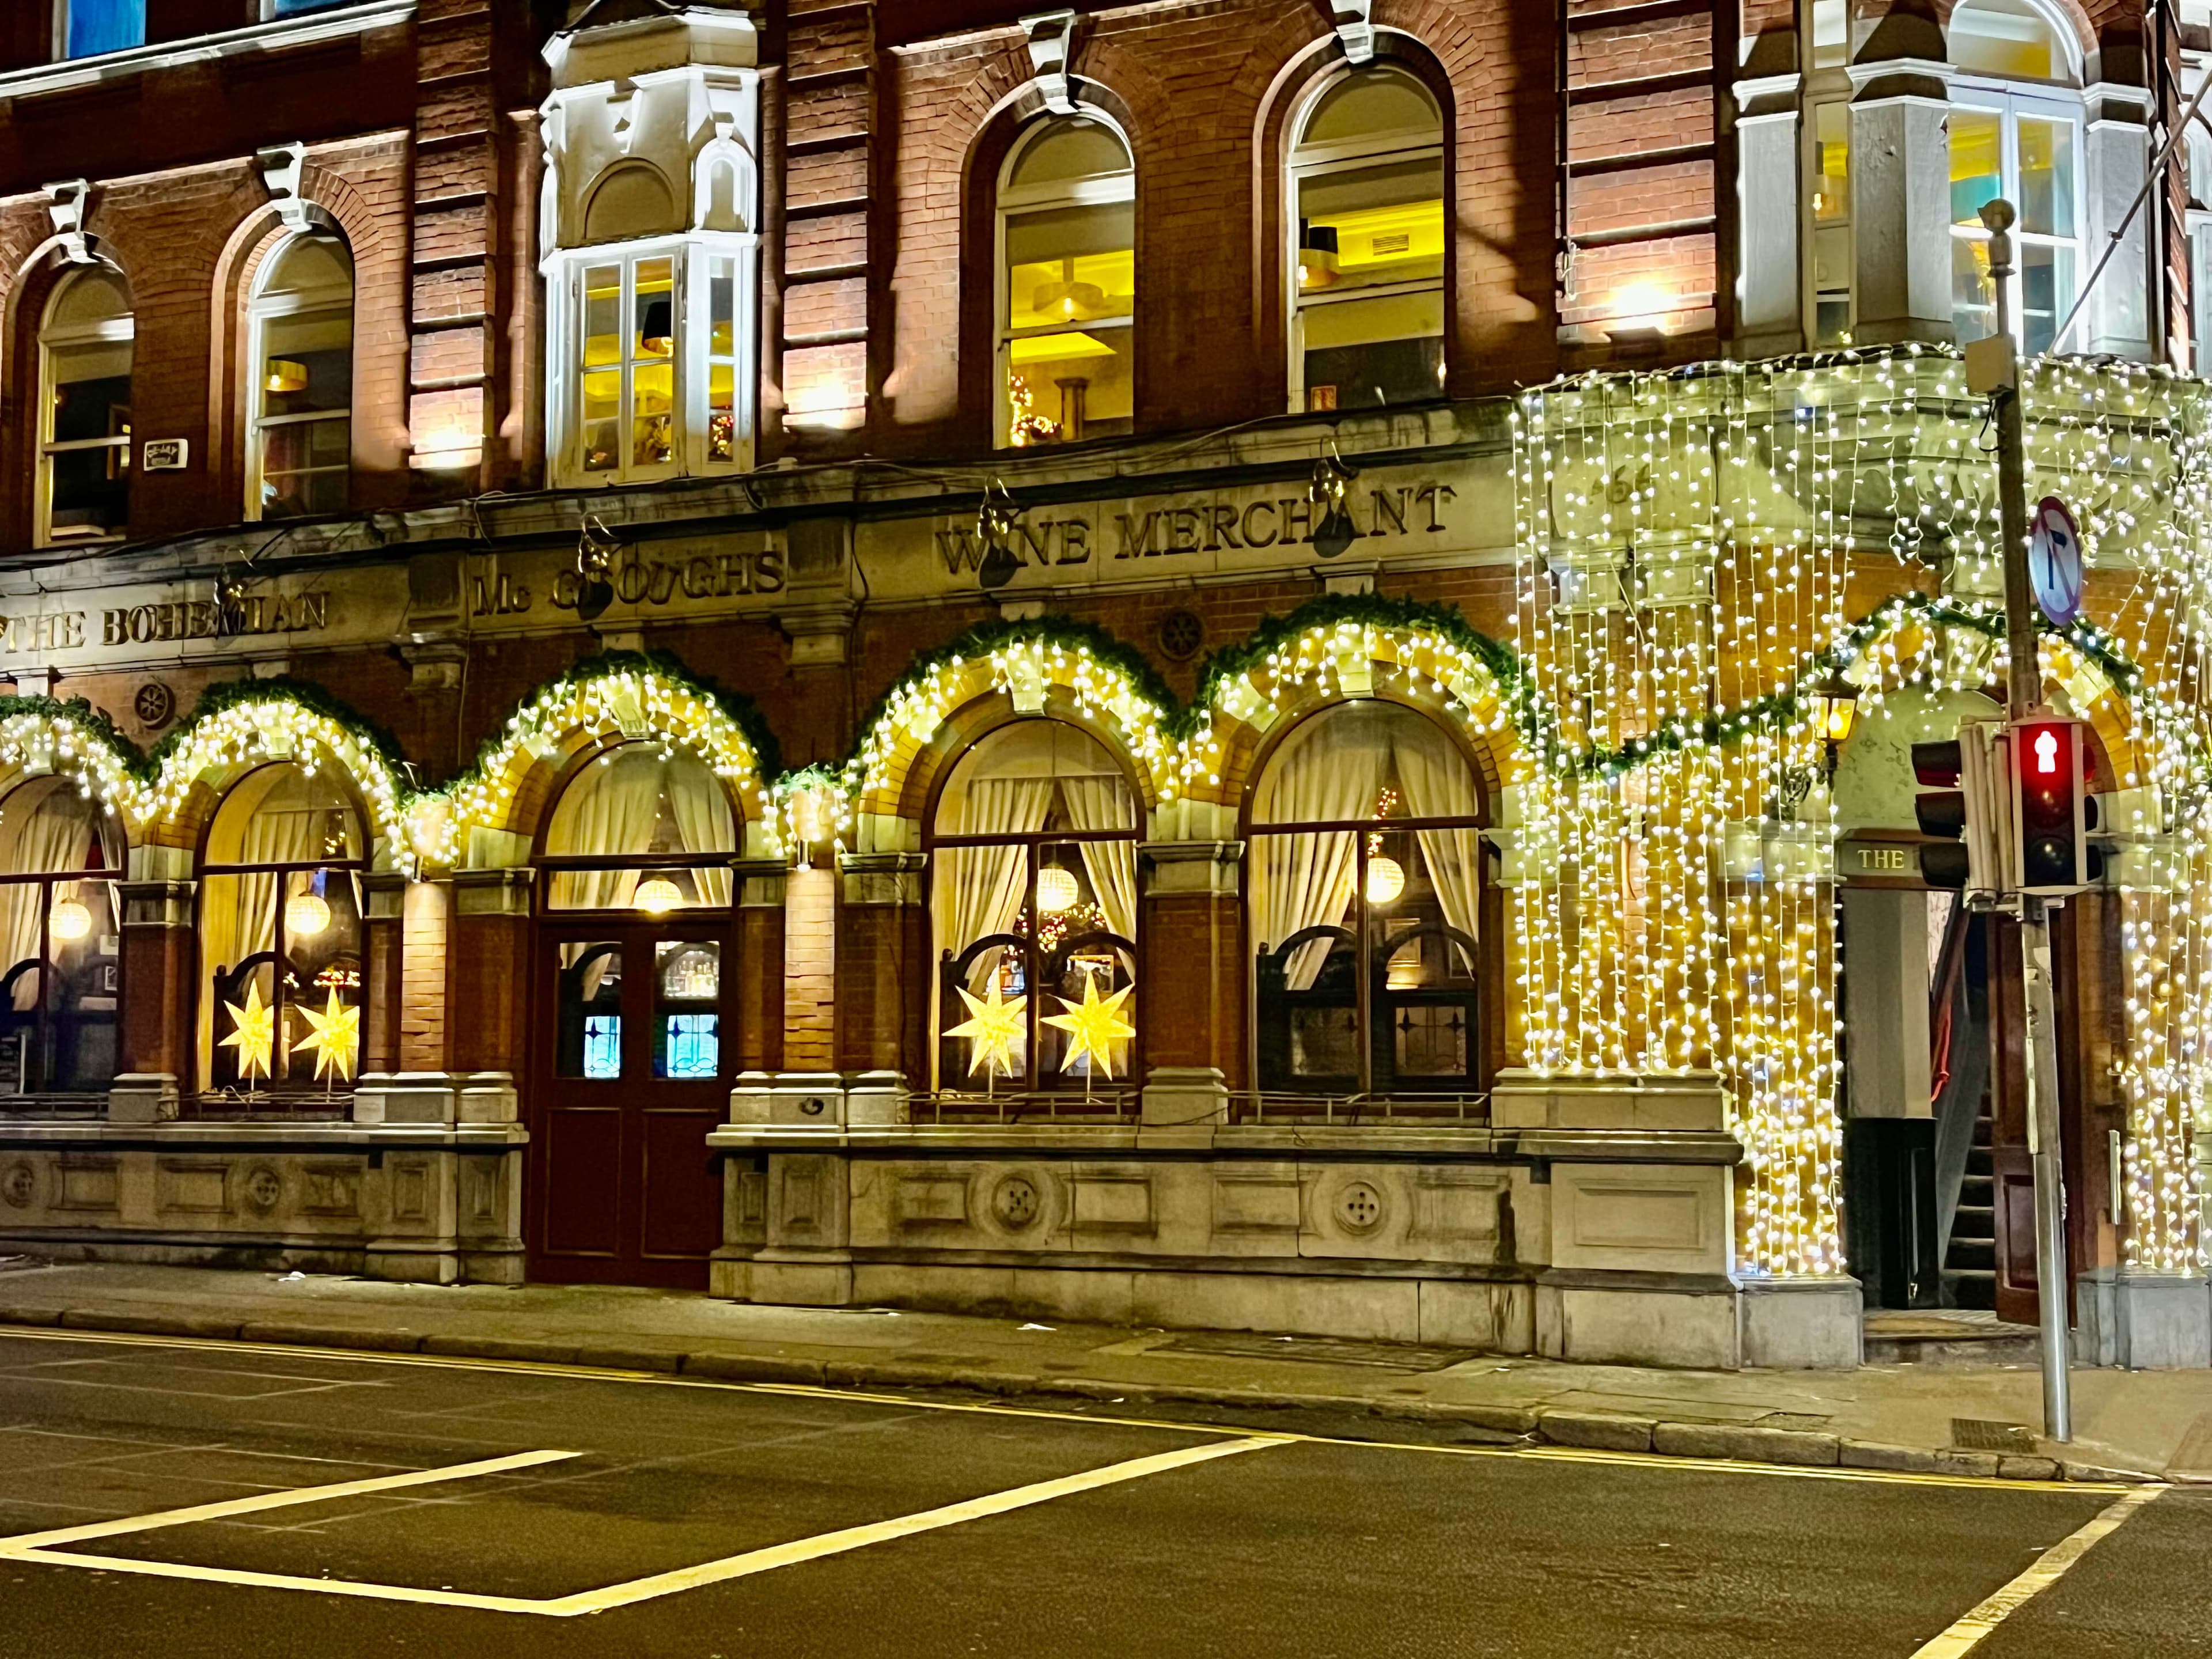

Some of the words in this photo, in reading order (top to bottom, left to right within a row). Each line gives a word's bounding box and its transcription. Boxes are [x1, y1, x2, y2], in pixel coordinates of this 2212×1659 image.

[935, 520, 1090, 574] WNE
[553, 551, 785, 609] GOUGHS
[6, 611, 86, 653] THE
[1857, 849, 1904, 869] THE
